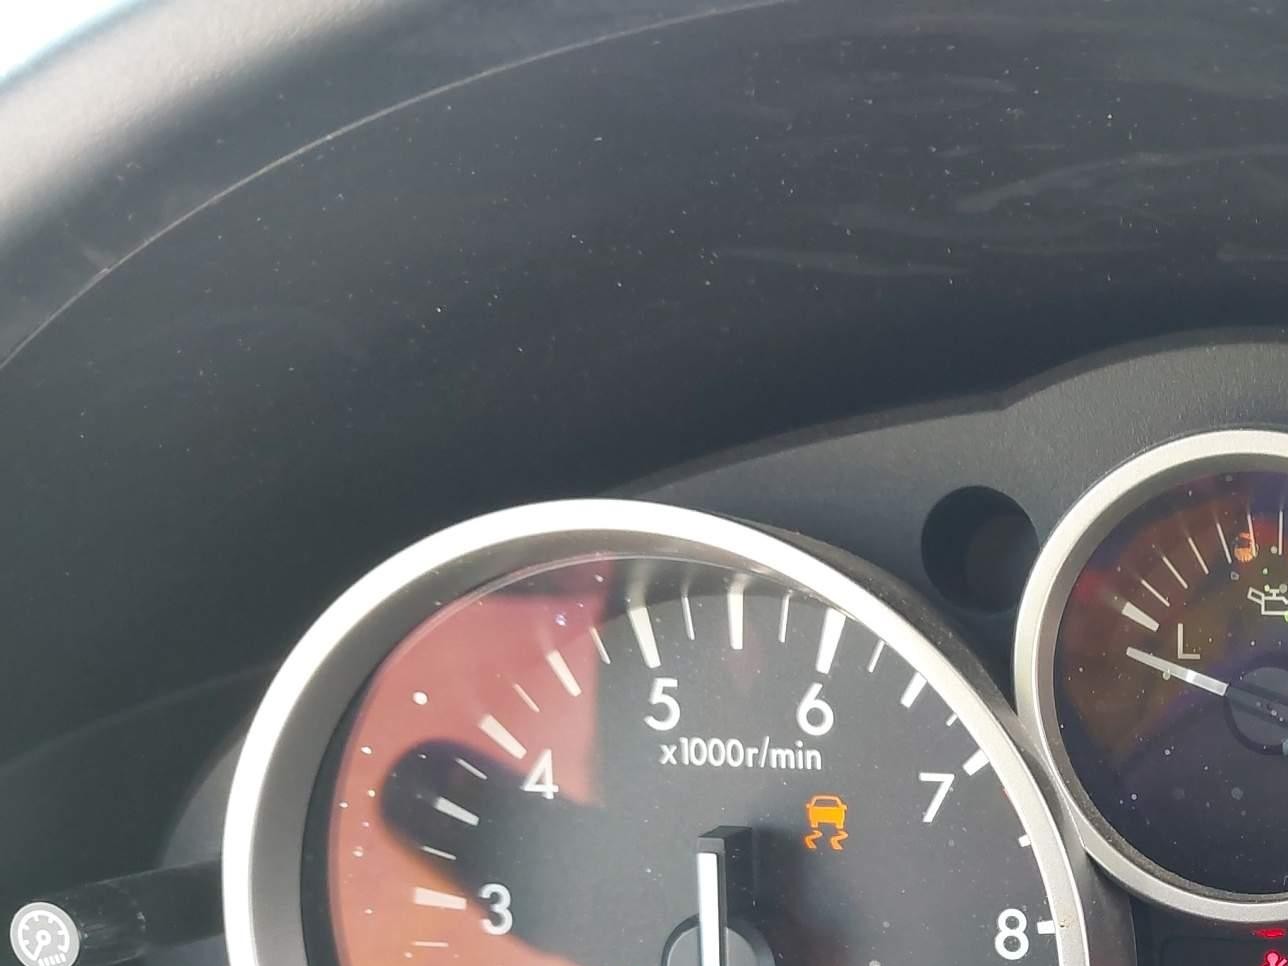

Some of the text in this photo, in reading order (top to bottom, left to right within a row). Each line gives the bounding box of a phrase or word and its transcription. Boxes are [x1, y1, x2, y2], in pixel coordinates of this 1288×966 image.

[1178, 623, 1201, 660] L
[643, 678, 681, 731] 5
[797, 682, 834, 736] 6
[523, 749, 559, 800] 4
[660, 736, 822, 771] x1000r/min
[918, 772, 955, 823] 7
[480, 884, 513, 935] 3
[994, 907, 1030, 961] 8
